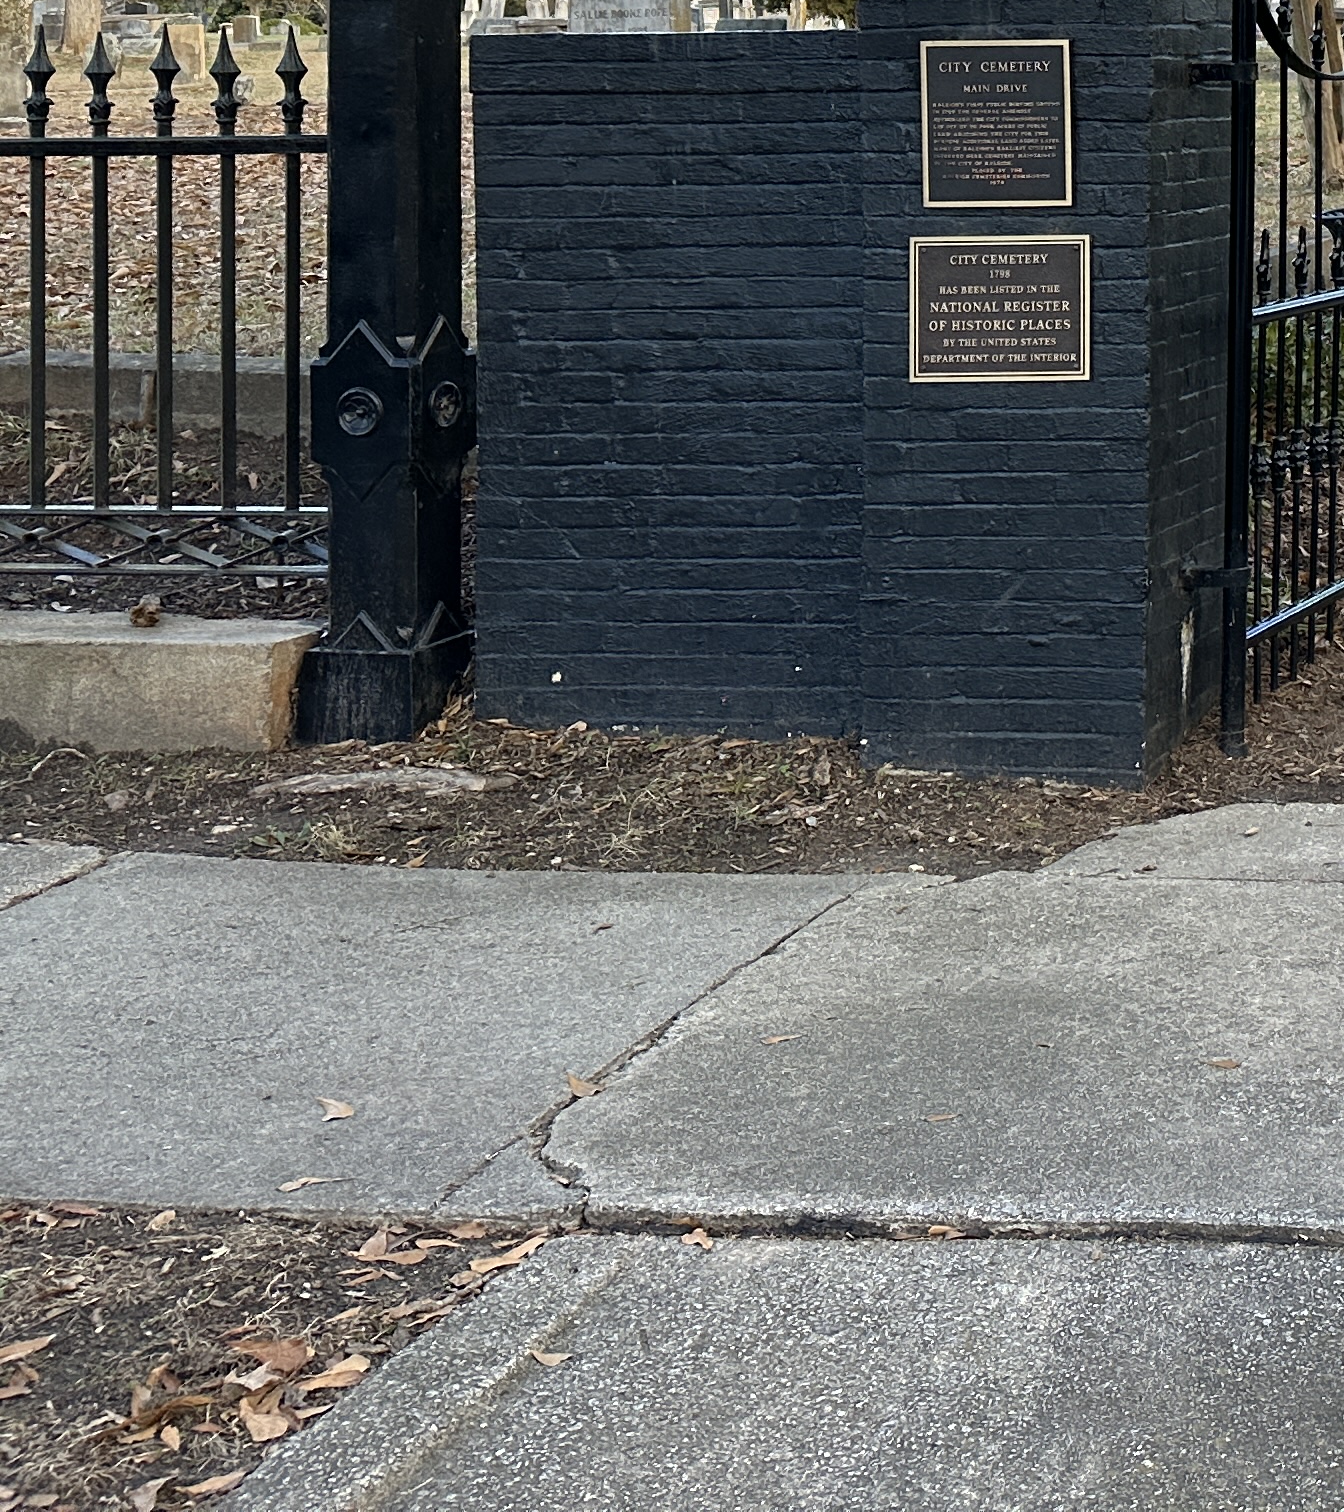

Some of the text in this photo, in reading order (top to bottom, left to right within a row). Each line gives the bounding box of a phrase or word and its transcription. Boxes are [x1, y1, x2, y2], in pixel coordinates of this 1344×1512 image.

[574, 7, 668, 20] SALLIE BOONE POPE
[939, 61, 1051, 72] CITY CEMETERY
[963, 84, 1028, 93] MAIN DRIVE
[949, 254, 1048, 265] CITY CEMETERY
[989, 270, 1010, 279] 1798
[939, 285, 1060, 295] HAS BEEN LISTED IN THE
[930, 300, 1070, 313] NATIONAL REGISTER
[928, 319, 1071, 332] OF HISTORIC PLACES
[943, 338, 1057, 347] BY THE UNITED STATES
[923, 353, 1077, 363] DEPARTMENT OF THE INTERIOR
